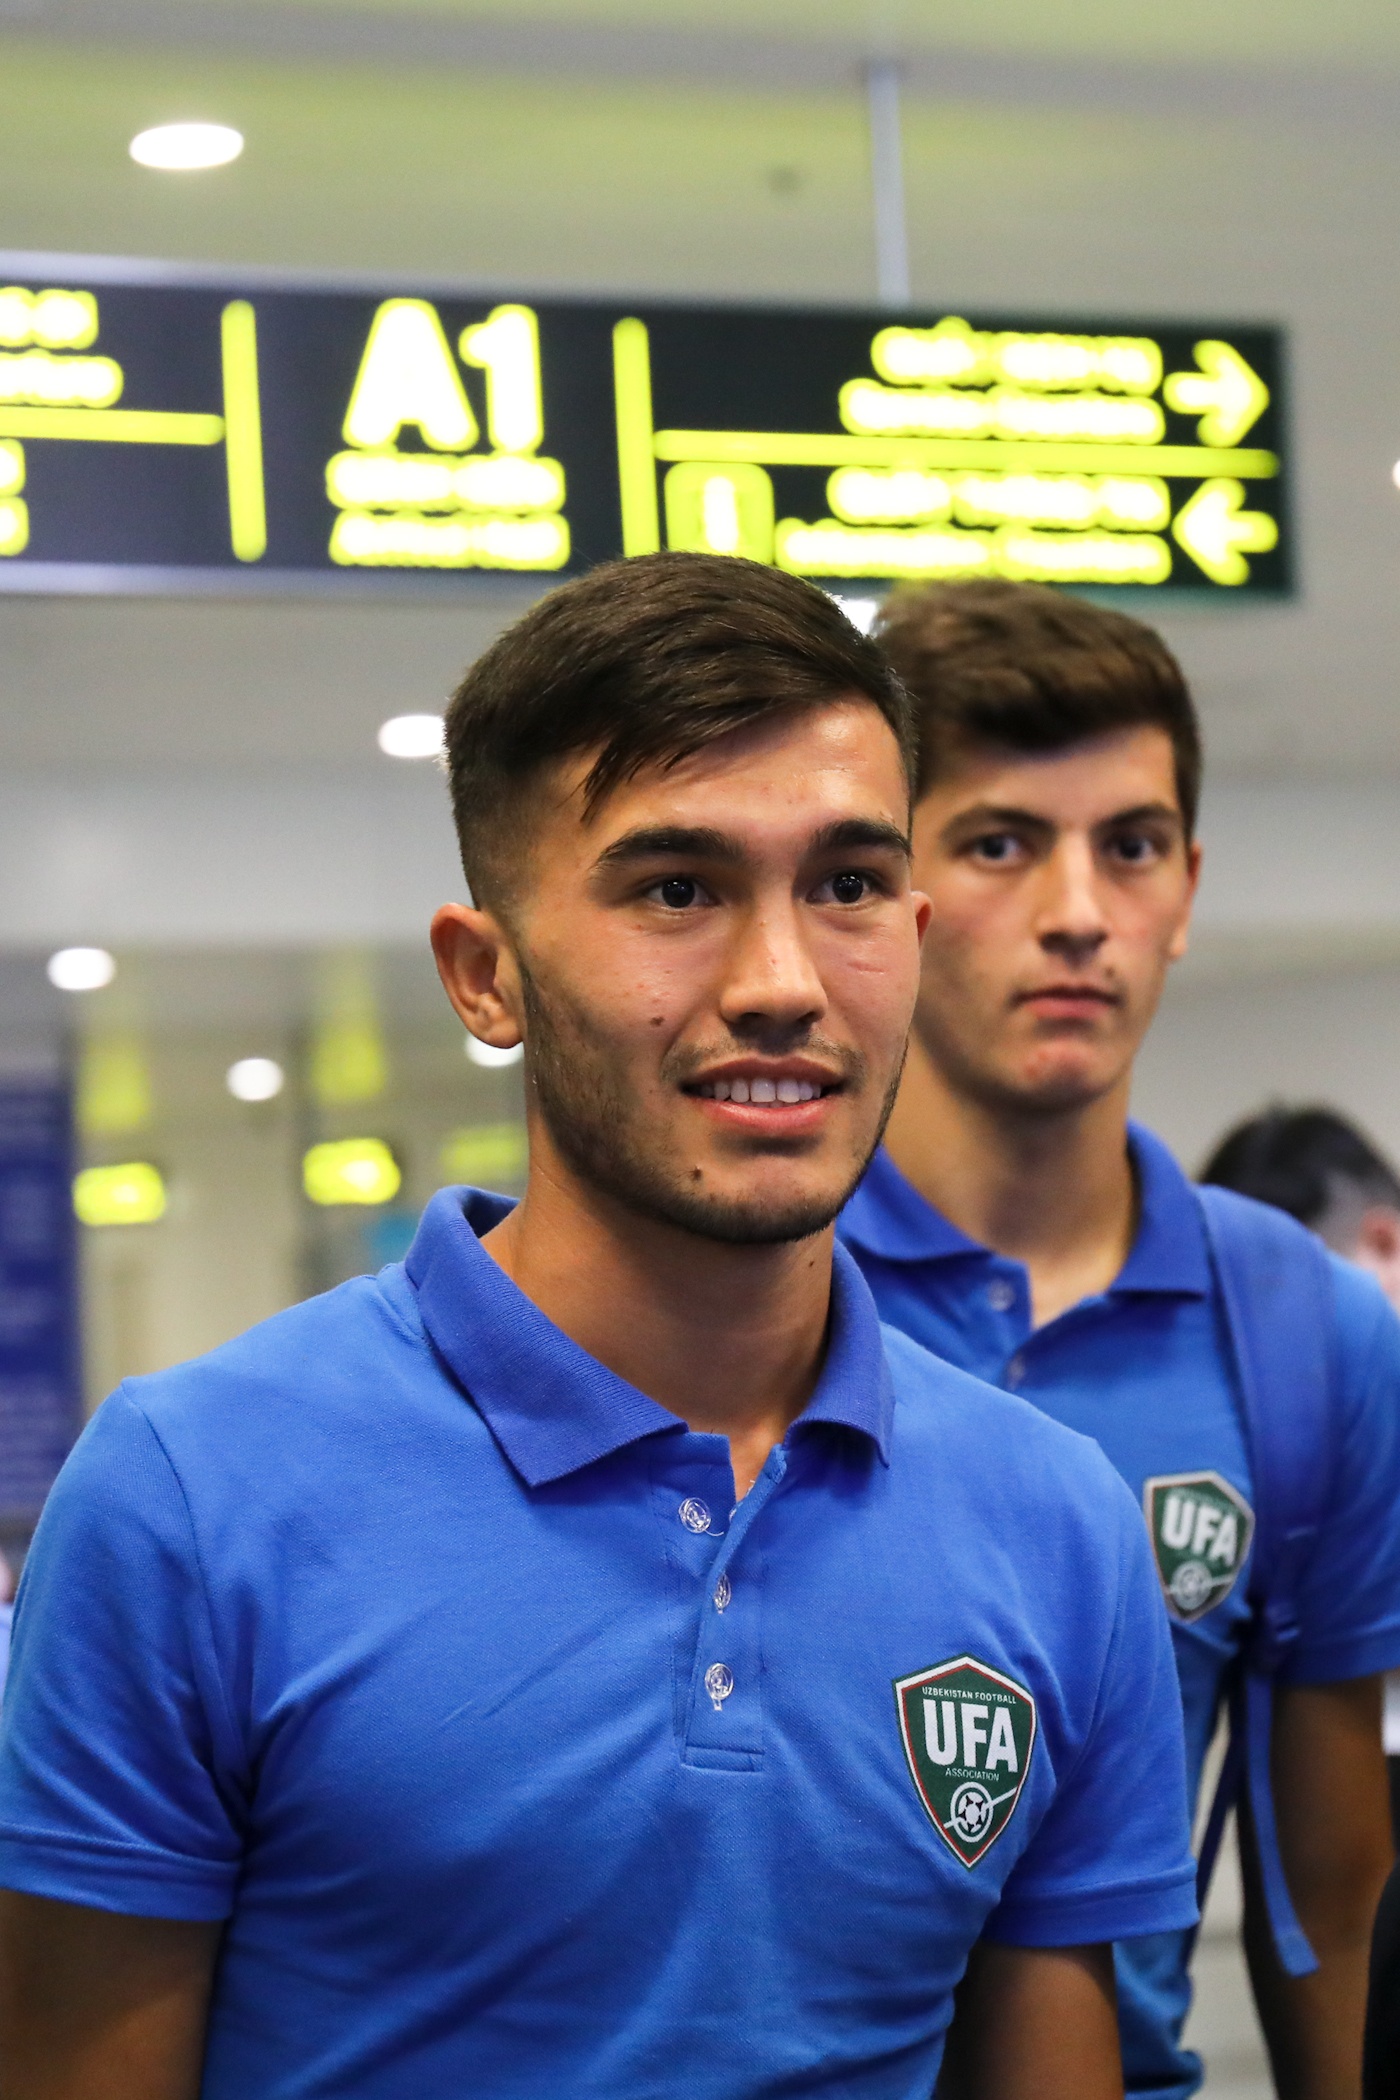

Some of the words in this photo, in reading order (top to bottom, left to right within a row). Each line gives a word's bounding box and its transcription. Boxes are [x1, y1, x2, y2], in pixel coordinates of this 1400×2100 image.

[342, 298, 545, 454] A1
[1160, 1494, 1238, 1567] UFA
[922, 1686, 973, 1699] UZBEKISTAN
[975, 1692, 1017, 1704] FOOTBALL
[922, 1698, 1019, 1773] UFA
[945, 1768, 1000, 1782] ASSOCIATION
